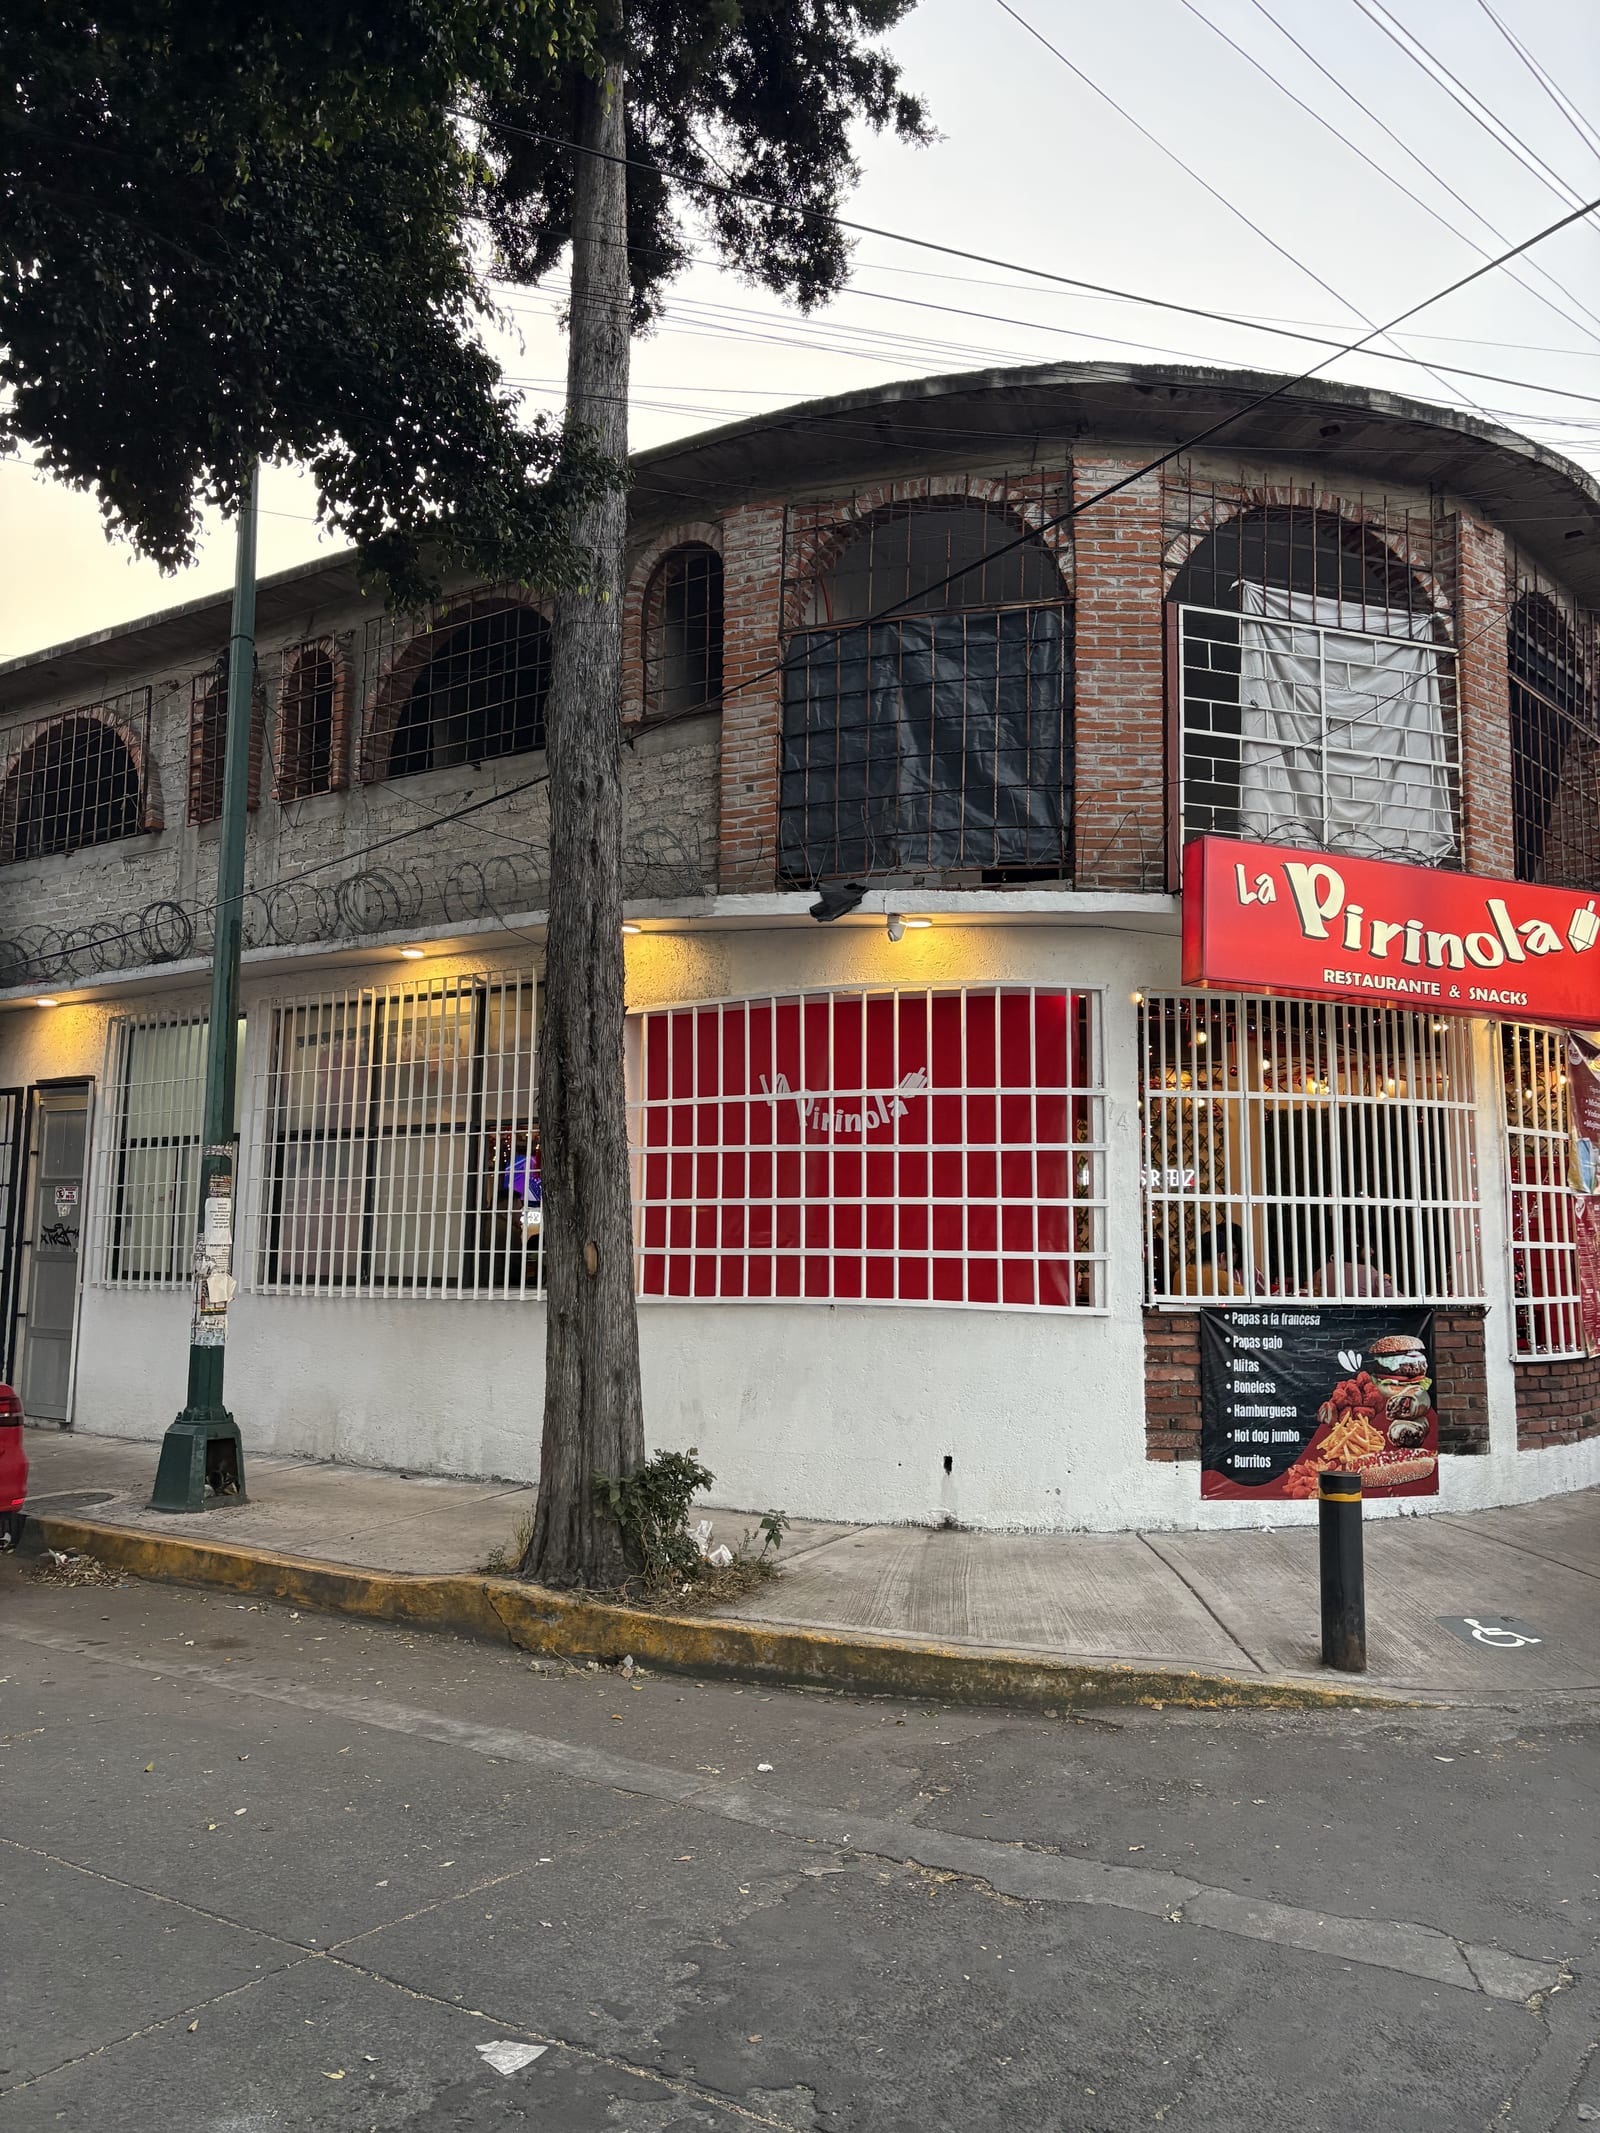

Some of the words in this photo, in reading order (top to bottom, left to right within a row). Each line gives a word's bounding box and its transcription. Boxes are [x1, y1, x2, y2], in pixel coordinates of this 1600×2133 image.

[1235, 863, 1276, 905] La
[1282, 862, 1563, 970] Pirinola
[1323, 968, 1441, 996] RESTAURANTE
[1449, 985, 1461, 998] &
[1469, 987, 1528, 1006] SNACKS
[1232, 1312, 1260, 1327] Papas
[1262, 1313, 1268, 1325] a
[1270, 1312, 1280, 1325] la
[1281, 1312, 1321, 1326] francesa
[1233, 1335, 1261, 1350] Papas
[1262, 1335, 1283, 1350] gajo
[1233, 1358, 1260, 1372] Alitas
[1233, 1380, 1276, 1394] Boneless
[1234, 1404, 1297, 1419] Hamburguesa
[1234, 1429, 1250, 1443] Hot
[1252, 1429, 1269, 1444] dog
[1271, 1429, 1300, 1444] jumbo
[1234, 1454, 1272, 1468] Burritos
